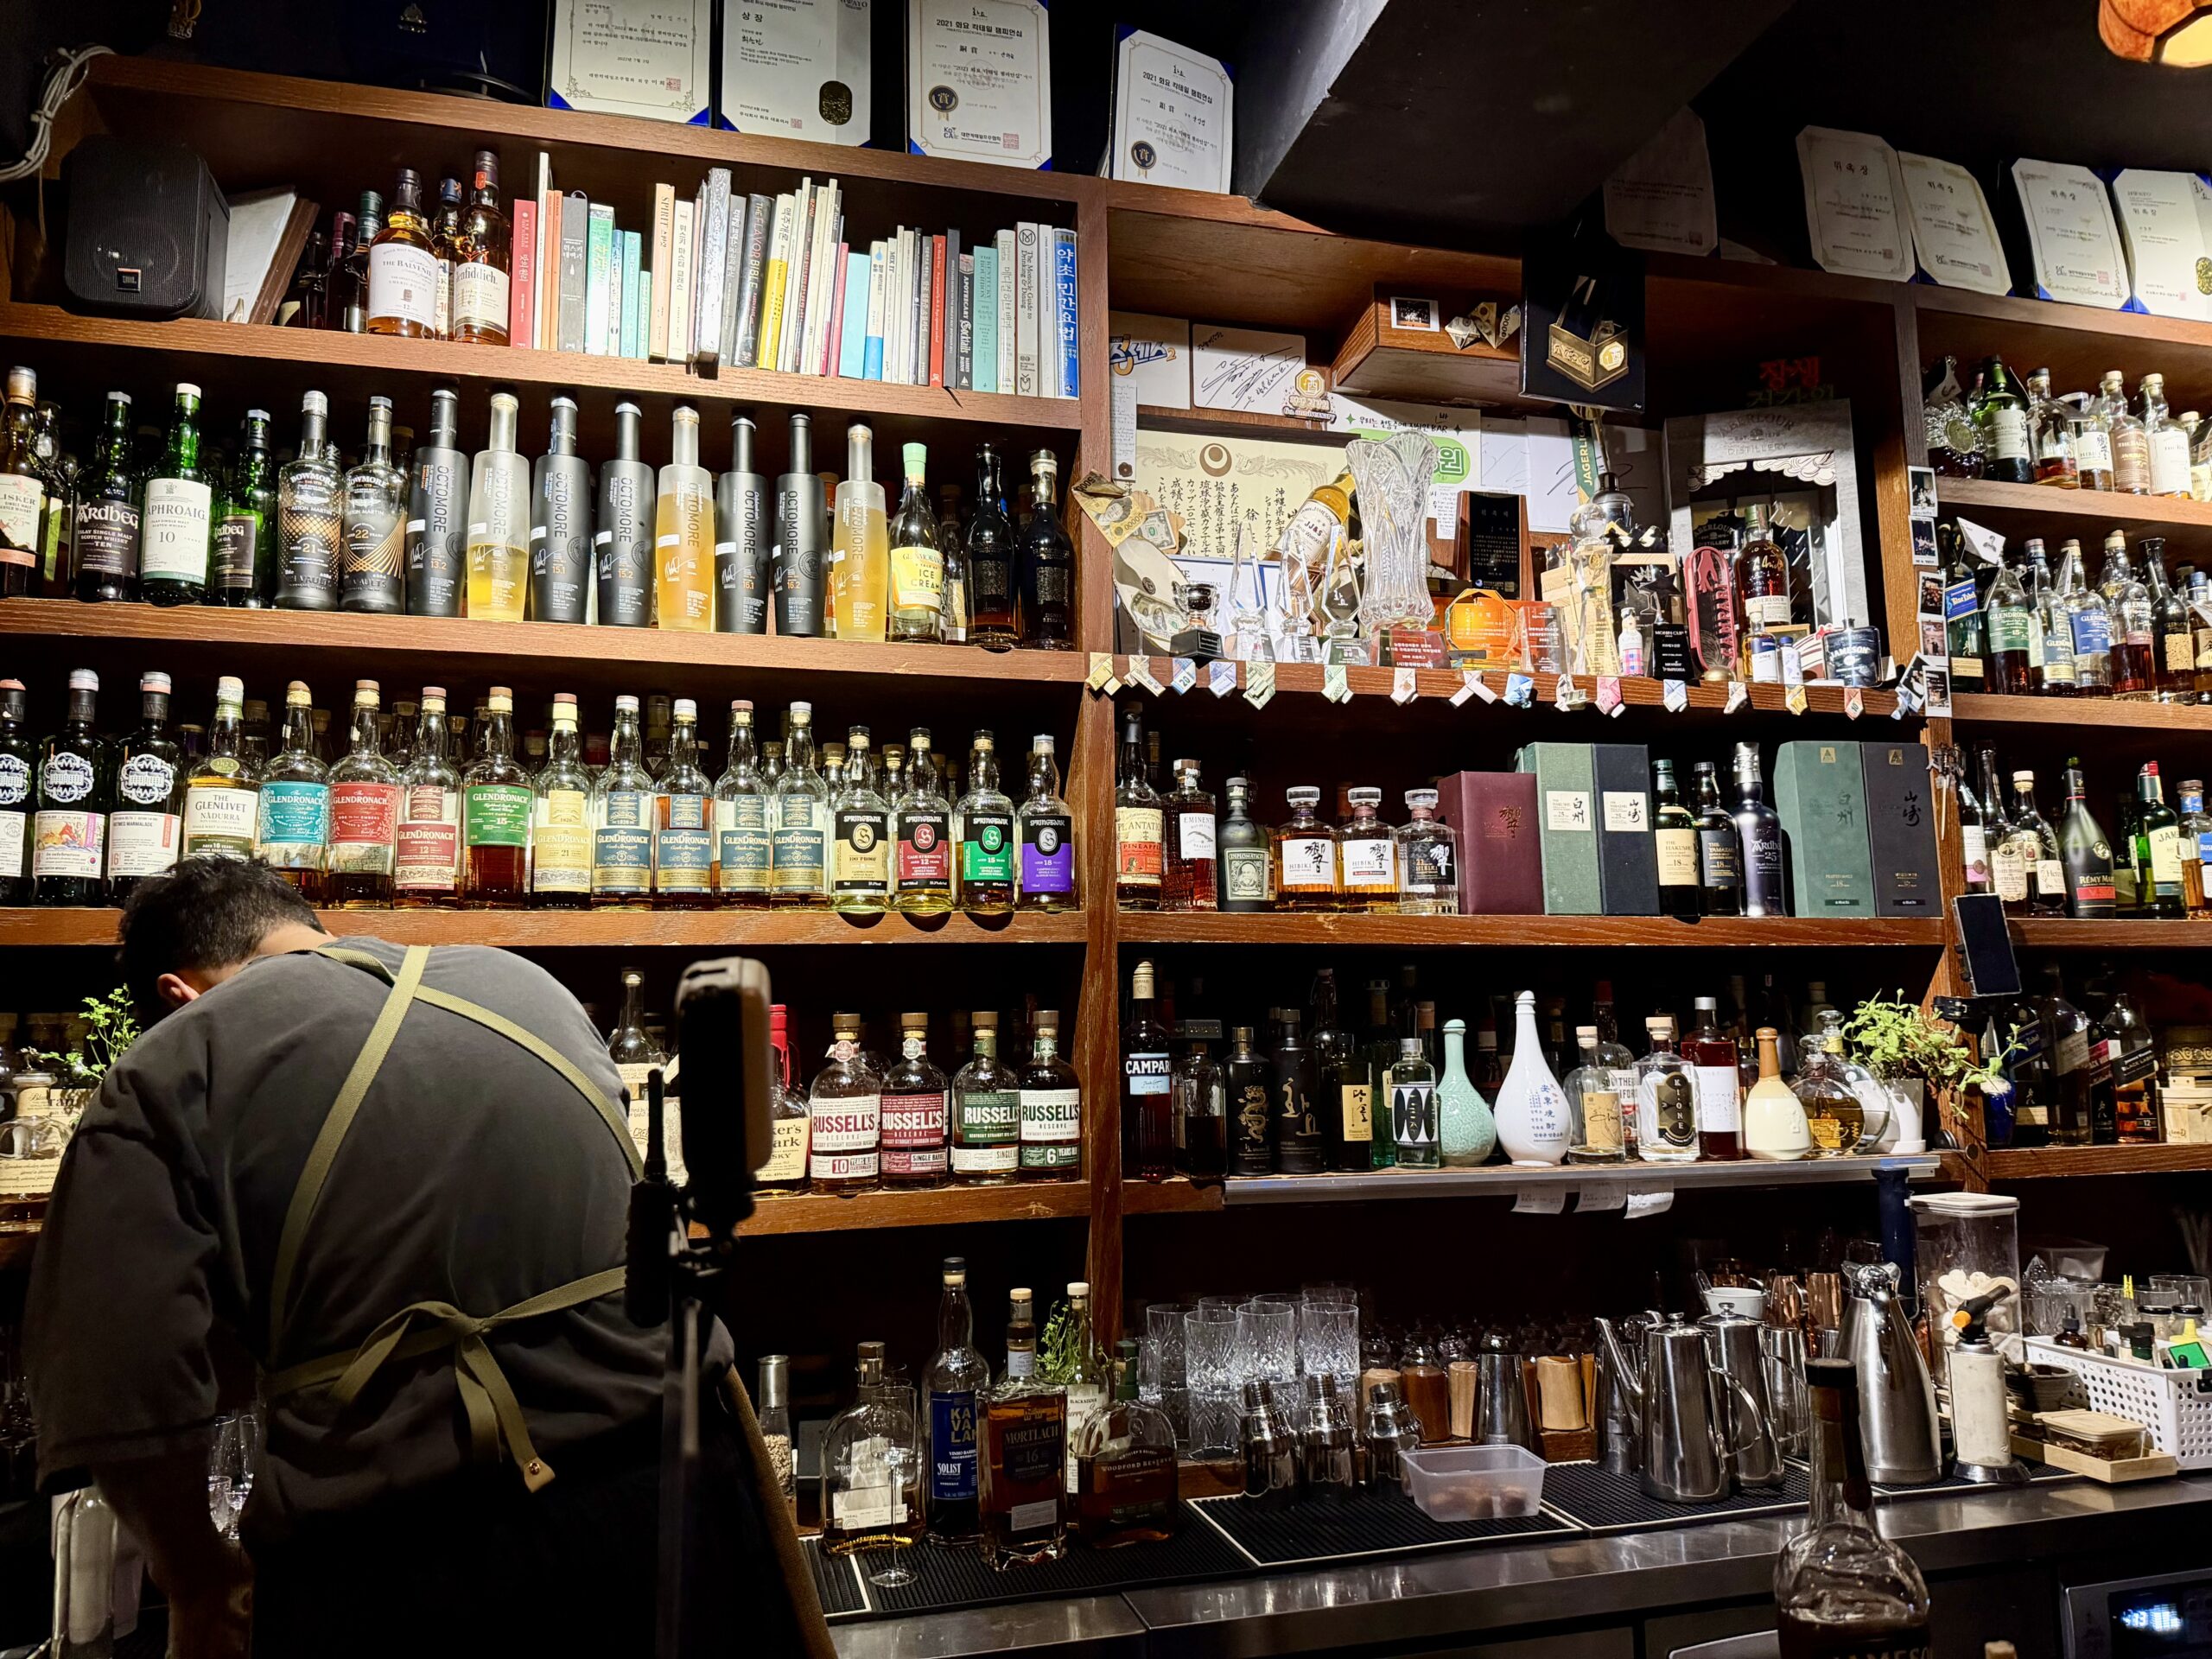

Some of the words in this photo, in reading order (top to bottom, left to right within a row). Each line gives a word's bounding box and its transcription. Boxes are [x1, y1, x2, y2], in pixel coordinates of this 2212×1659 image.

[936, 19, 953, 28] 2021
[1142, 71, 1157, 82] 2021
[660, 195, 670, 227] SPIRIT
[754, 202, 764, 216] THE
[750, 217, 763, 258] FLAVOR
[748, 258, 760, 289] BIBLE
[290, 473, 335, 488] BOWMORE
[0, 493, 36, 505] LISKER
[434, 465, 449, 533] OCTOMORE
[493, 467, 509, 536] OCTOMORE
[147, 503, 207, 519] APHROAIG
[310, 506, 333, 515] MARTIN
[553, 473, 568, 538] OCTOMORE
[619, 477, 632, 543] OCTOMORE
[687, 482, 701, 548] OCTOMORE
[744, 490, 756, 555] OCTOMORE
[786, 490, 798, 554] OCTOMORE
[354, 529, 369, 539] 22
[851, 497, 864, 561] OCTOMORE
[158, 531, 175, 543] 10
[302, 543, 317, 554] 21
[430, 560, 447, 570] 13.2
[552, 565, 565, 574] 15.1
[618, 570, 633, 579] 15.2
[918, 569, 935, 578] ICE
[742, 581, 754, 590] 16.1
[786, 581, 801, 589] 16.2
[1828, 646, 1871, 657] JAMESON
[268, 795, 323, 805] GLENDRONACH
[333, 795, 388, 804] GLENDRONACH
[473, 792, 528, 802] GLENDRONACH
[195, 800, 247, 813] GLENLIVET
[1572, 797, 1585, 824] 白州
[398, 830, 455, 840] GLENDRONACH
[597, 834, 650, 845] GLENDRONACH
[660, 835, 710, 845] GLENDRONACH
[723, 836, 771, 846] GLENDRONACH
[774, 835, 823, 845] GLENDRONACH
[1764, 852, 1777, 861] 25
[1022, 1103, 1079, 1122] RUSSELL'S
[813, 1113, 875, 1134] RUSSELL'S
[881, 1110, 943, 1130] RUSSELL'S
[772, 1137, 800, 1147] ark
[1046, 1148, 1057, 1165] 6
[833, 1160, 849, 1173] 10
[950, 1408, 971, 1419] KA
[950, 1420, 971, 1431] VA
[1004, 1425, 1058, 1443] MORTLACH
[937, 1462, 961, 1476] SOLIST
